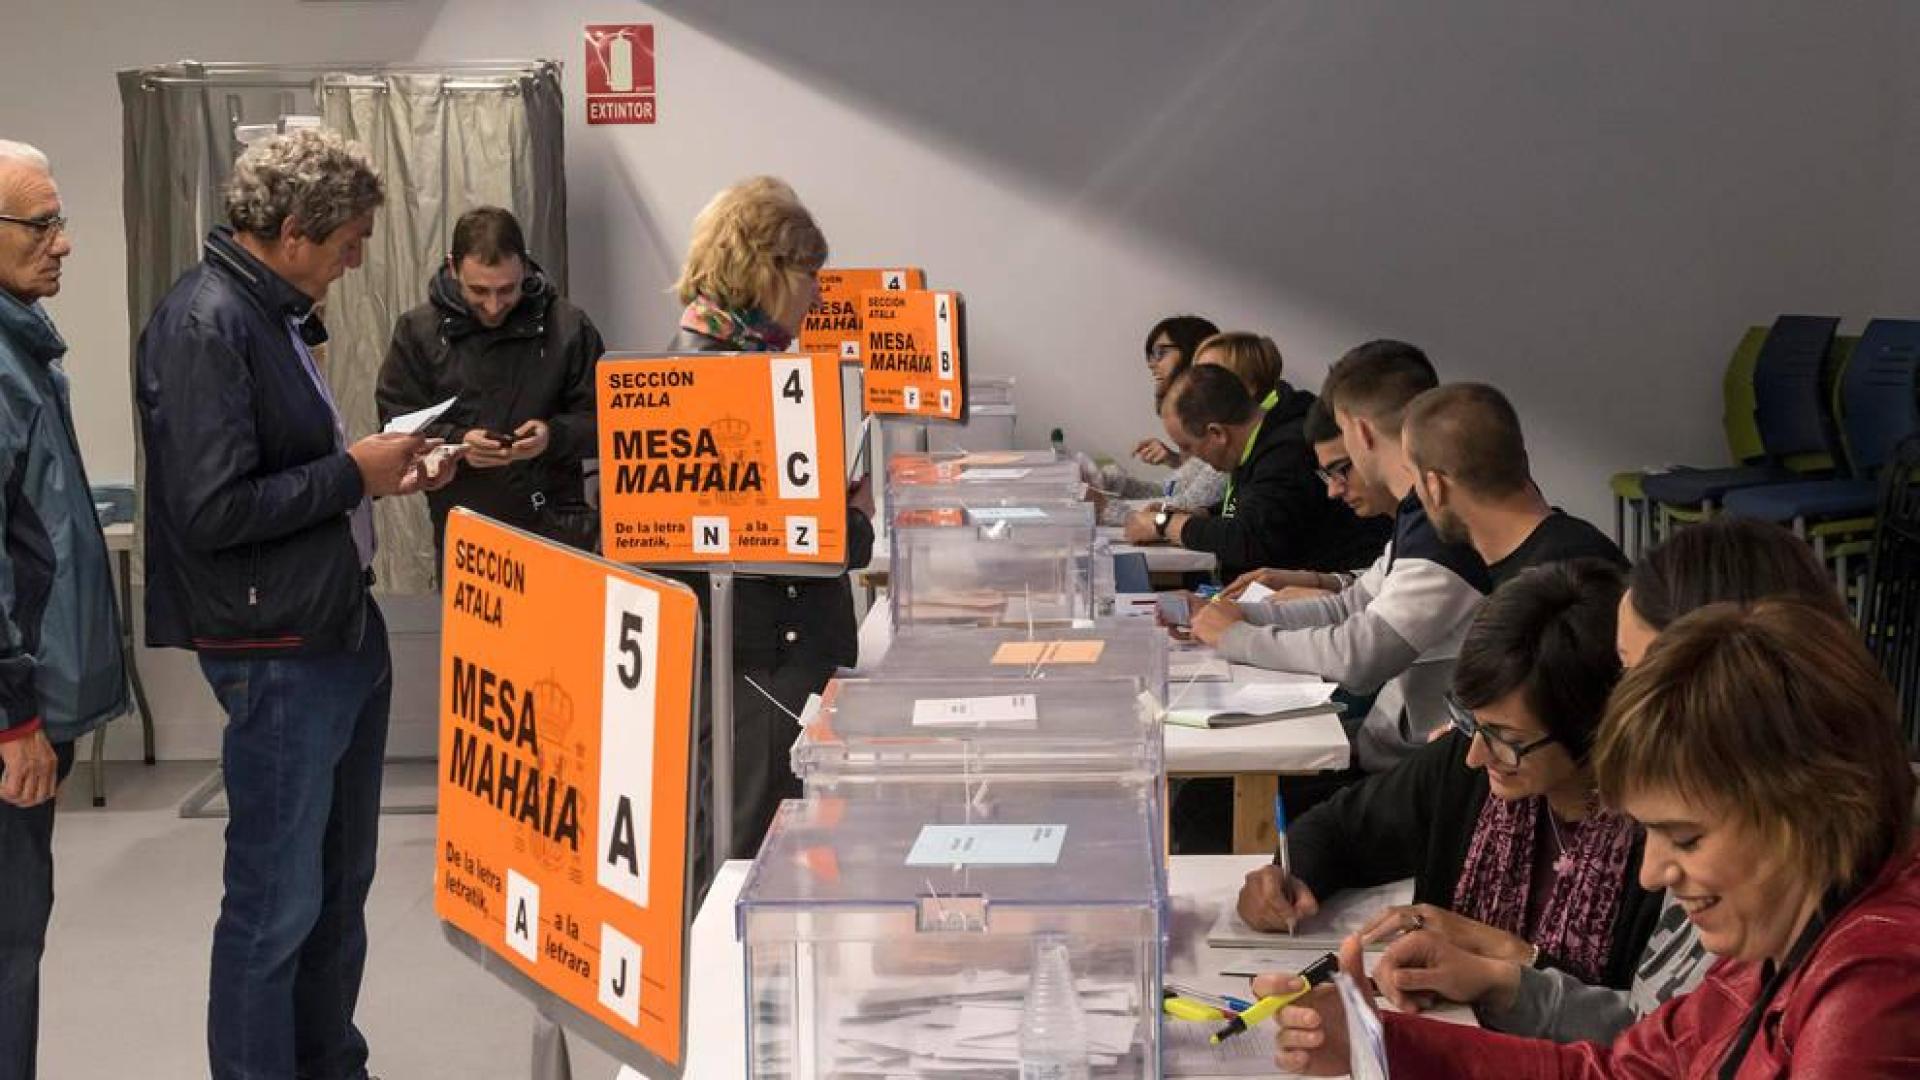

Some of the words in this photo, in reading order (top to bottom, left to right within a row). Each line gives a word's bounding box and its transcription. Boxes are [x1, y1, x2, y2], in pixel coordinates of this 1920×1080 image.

[591, 102, 652, 118] EXTINTOR
[888, 276, 900, 290] 4
[939, 301, 948, 322] 4
[870, 331, 917, 352] MESA
[870, 353, 932, 374] MAHAIA
[942, 351, 949, 372] B
[608, 367, 695, 389] SECCIÓN
[782, 368, 804, 404] 4
[610, 391, 670, 410] ATALA
[613, 427, 719, 460] MESA
[615, 462, 762, 495] MAHAIA
[786, 451, 810, 487] C
[615, 522, 633, 533] De
[637, 521, 650, 533] la
[653, 521, 686, 533] letra
[703, 526, 719, 546] N
[738, 534, 780, 547] letrara
[745, 522, 753, 532] a
[756, 520, 769, 532] la
[796, 526, 809, 546] Z
[455, 539, 525, 594] SECCIÓN
[453, 580, 503, 628] ATALA
[616, 610, 643, 690] 5
[452, 655, 538, 756] MESA
[449, 727, 579, 852] MAHAIA
[607, 794, 639, 877] A
[445, 840, 461, 867] De
[464, 850, 474, 875] la
[476, 857, 501, 893] letra
[515, 897, 529, 941] A
[553, 913, 563, 932] a
[565, 914, 579, 939] la
[545, 934, 591, 979] letrara
[612, 957, 627, 998] J
